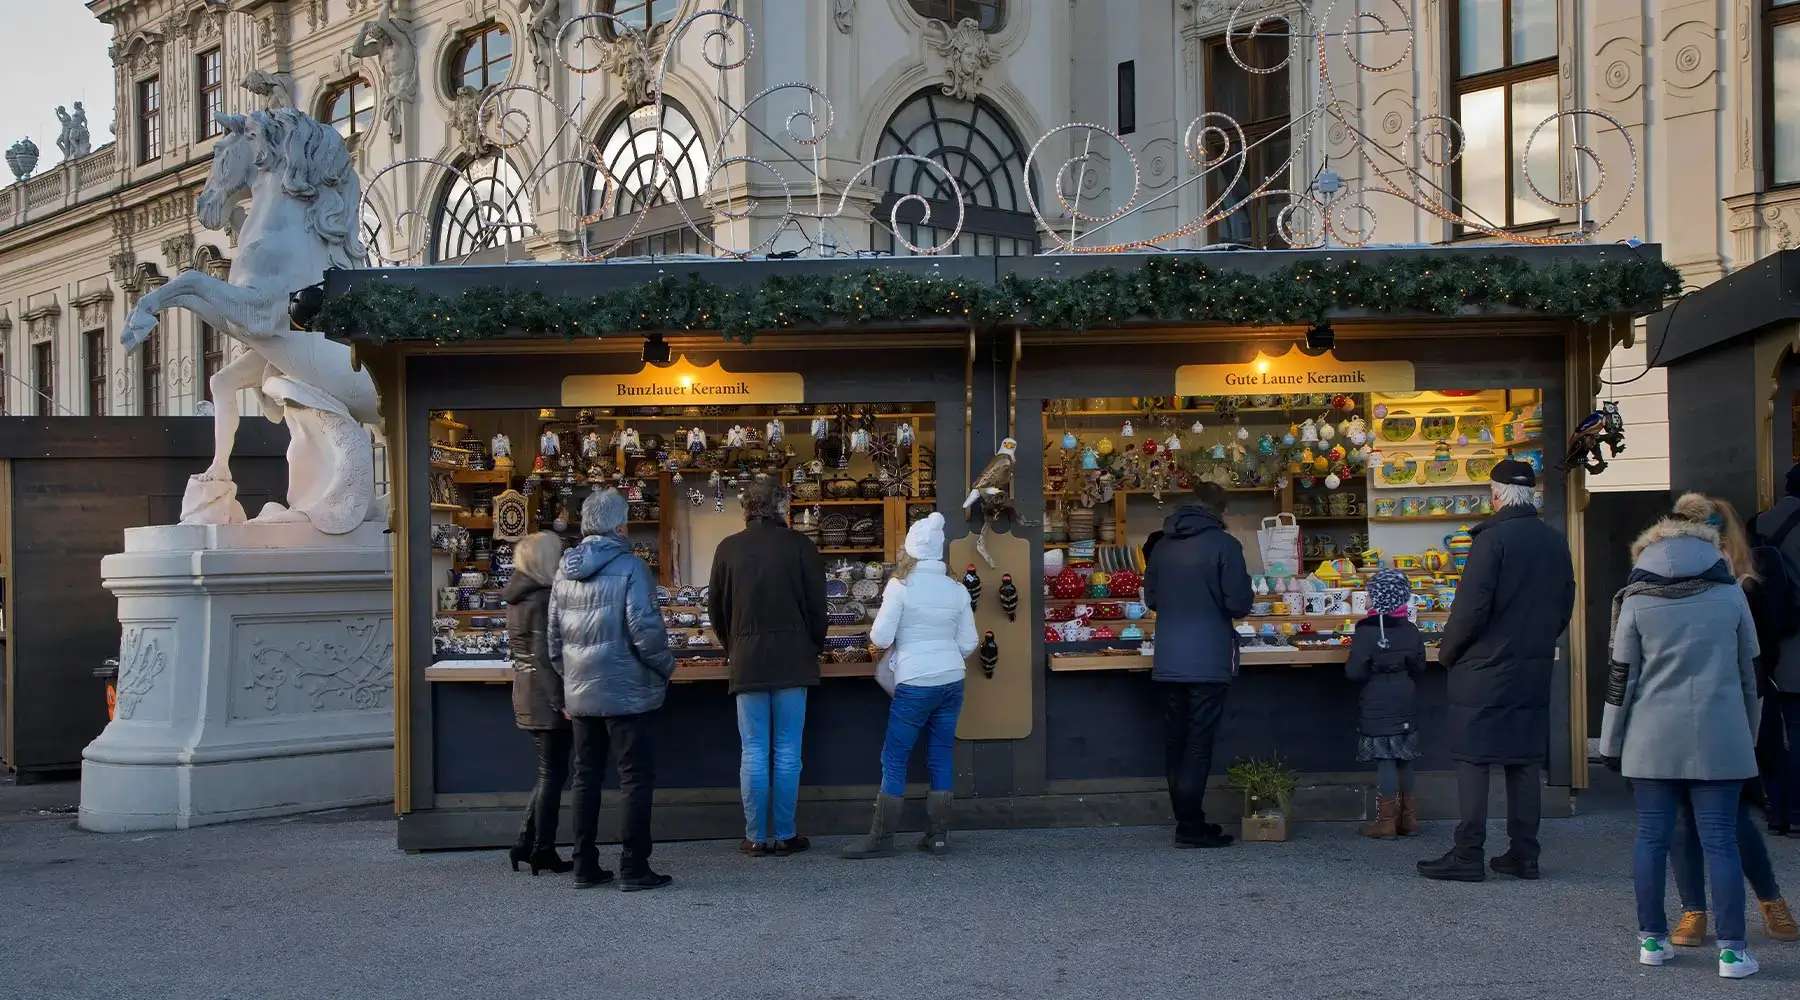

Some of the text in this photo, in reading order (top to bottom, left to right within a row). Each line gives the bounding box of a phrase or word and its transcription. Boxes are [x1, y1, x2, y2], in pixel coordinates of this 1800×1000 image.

[1225, 371, 1366, 385] Gute Laune Keramik
[616, 382, 749, 396] Bunzlauer Keramik
